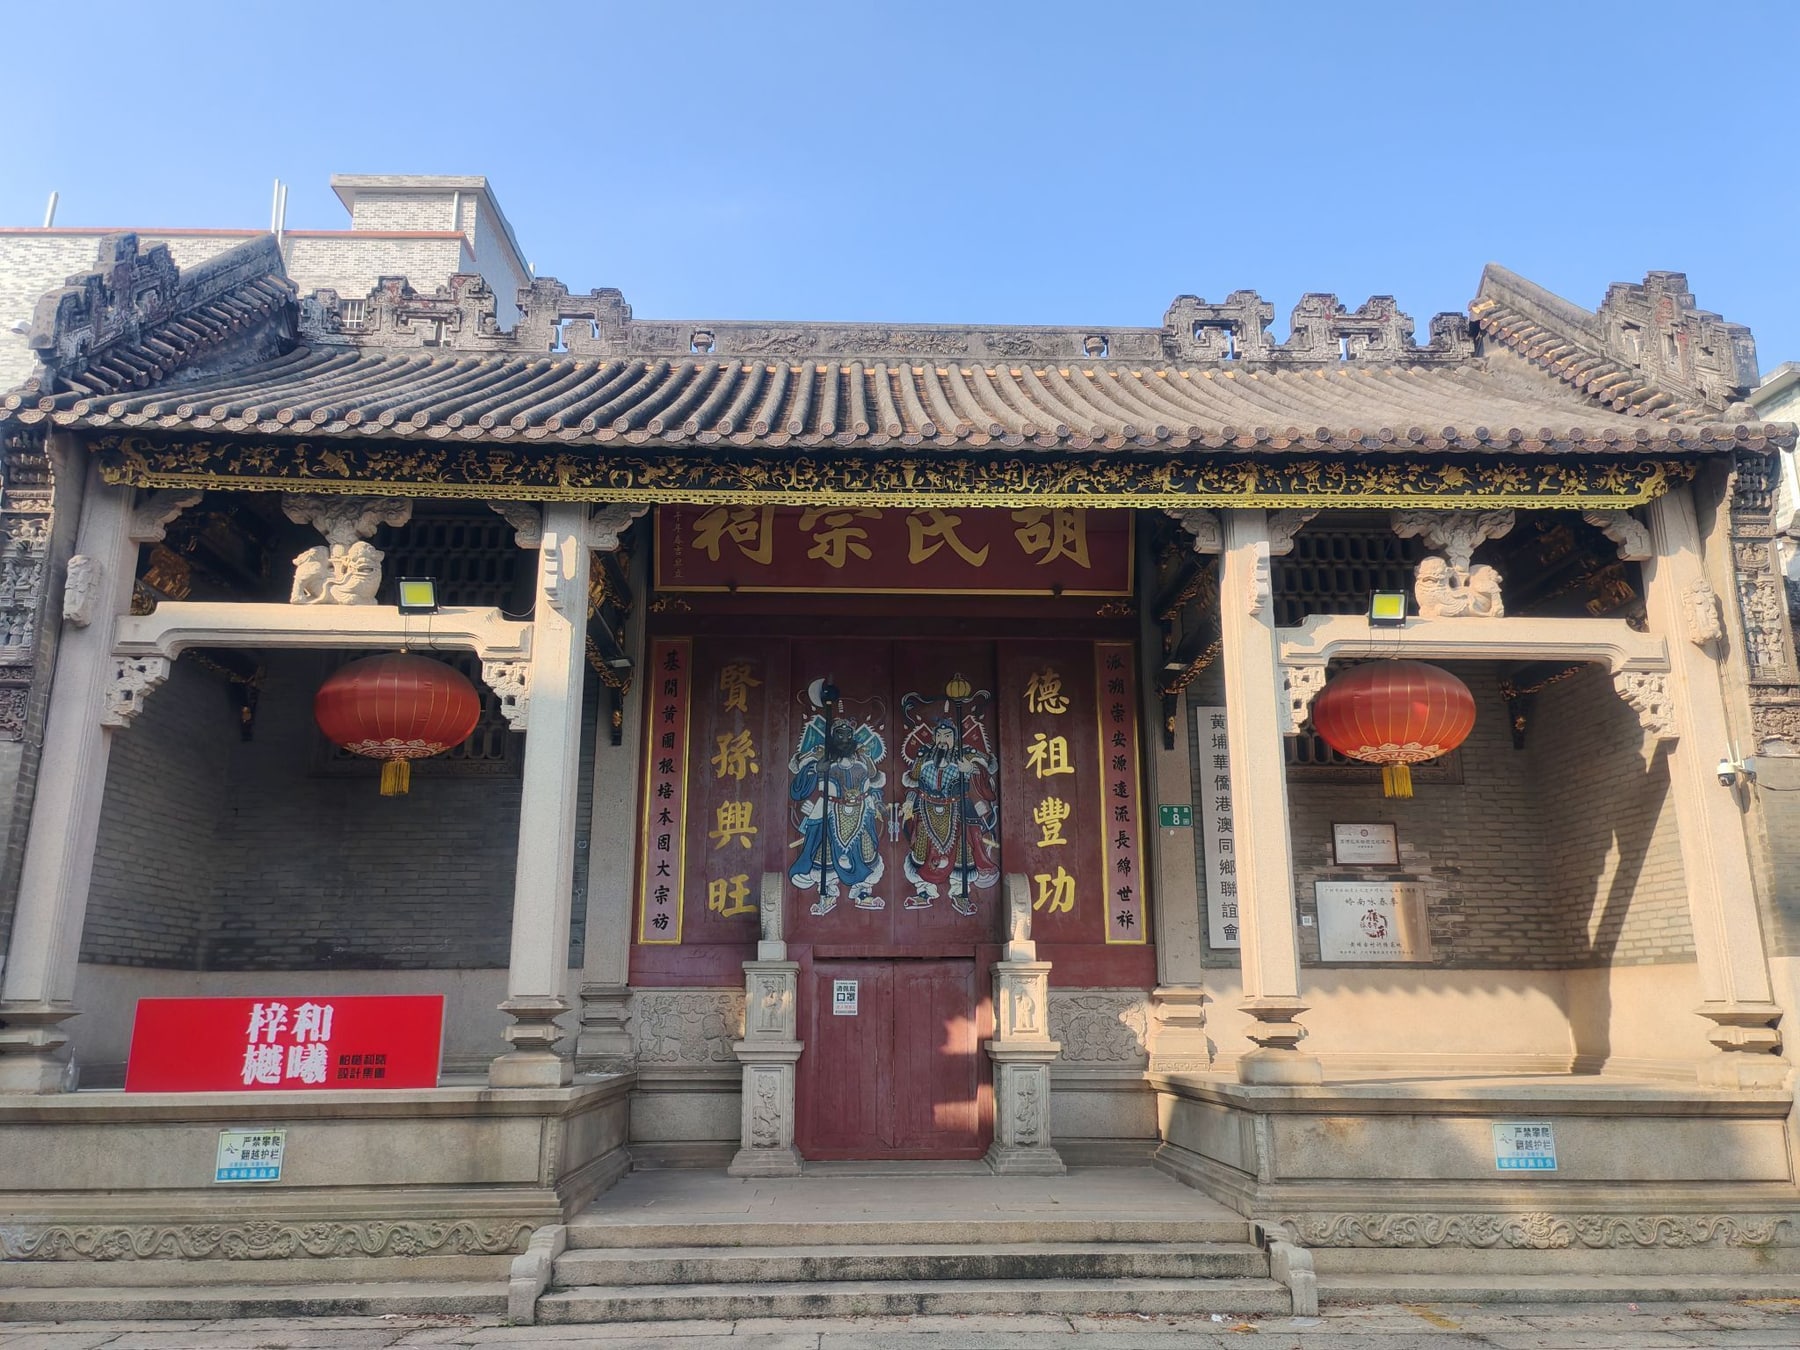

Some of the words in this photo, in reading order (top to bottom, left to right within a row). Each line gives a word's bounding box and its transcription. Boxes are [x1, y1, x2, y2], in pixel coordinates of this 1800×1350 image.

[708, 664, 764, 918] 賢孫興旺
[1173, 813, 1180, 825] 8
[242, 1136, 281, 1147] 严禁攀爬
[240, 1148, 280, 1160] 翻越护栏
